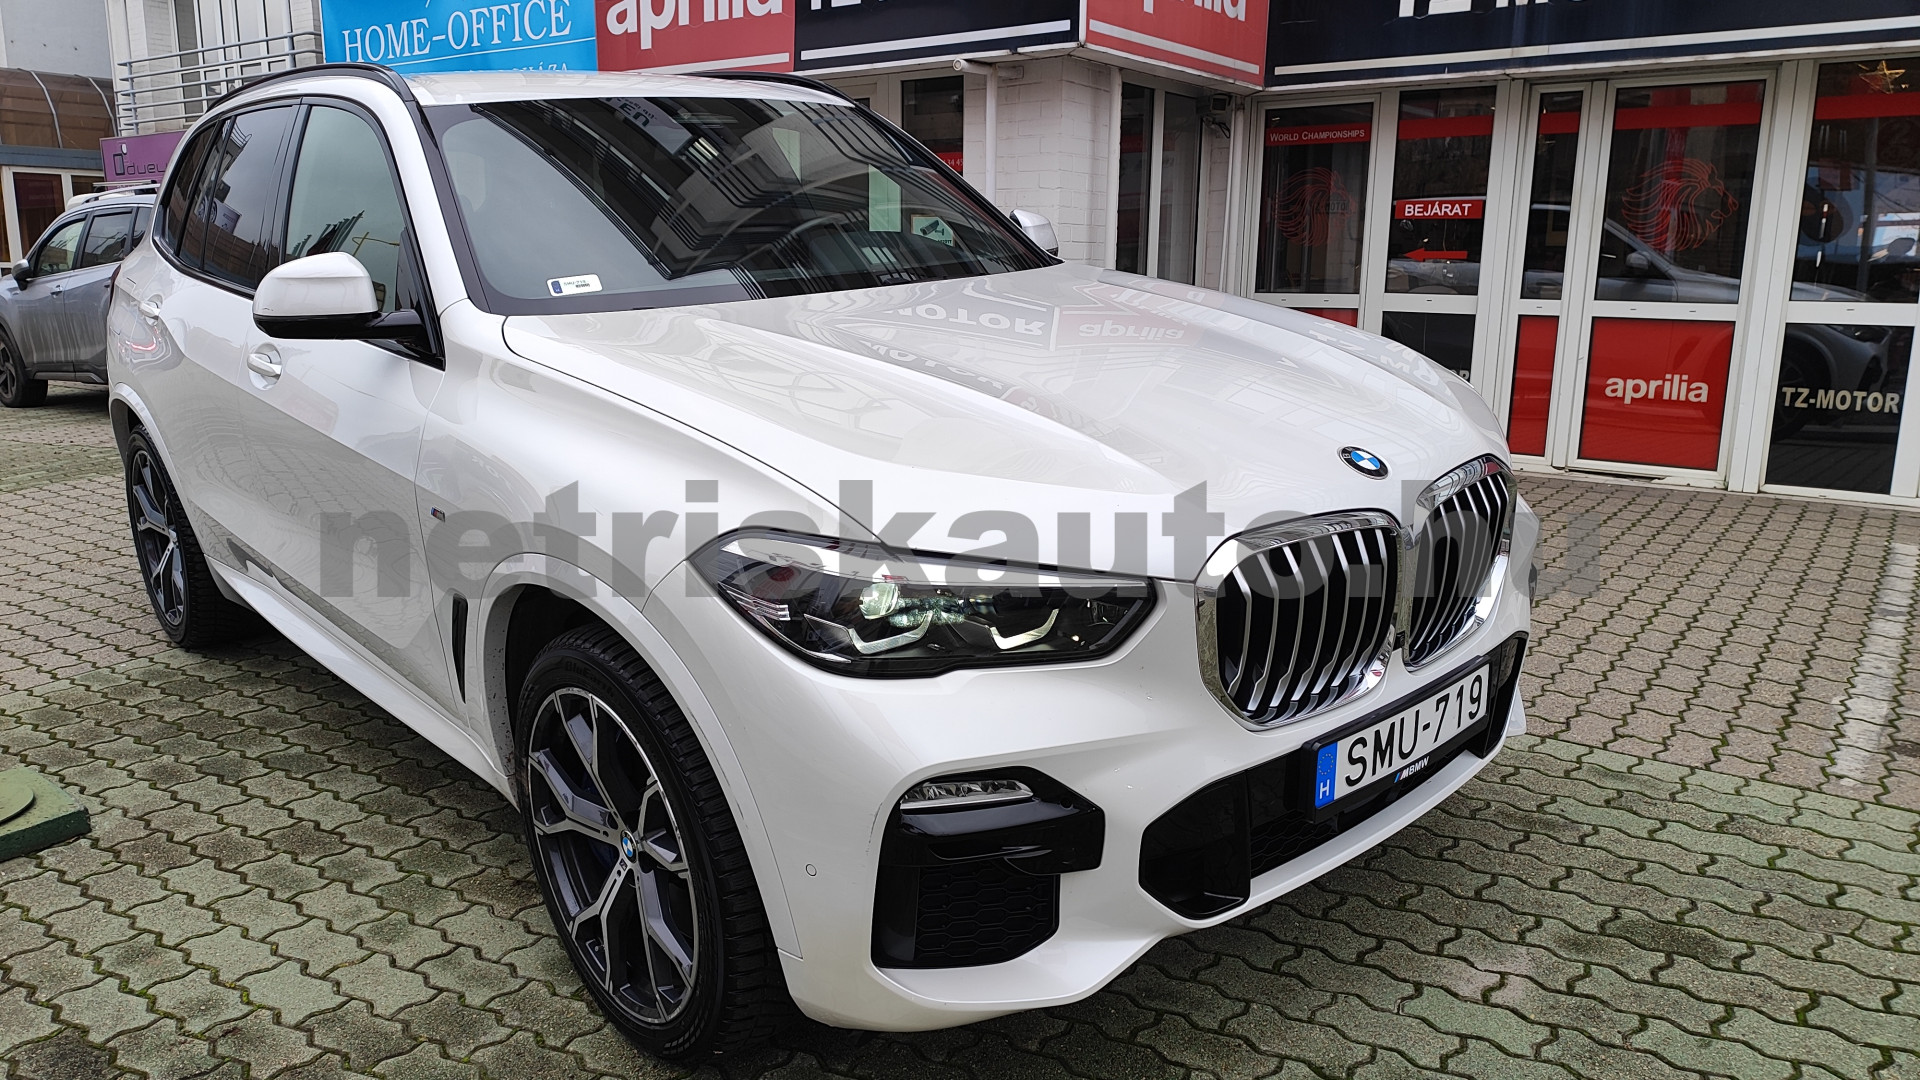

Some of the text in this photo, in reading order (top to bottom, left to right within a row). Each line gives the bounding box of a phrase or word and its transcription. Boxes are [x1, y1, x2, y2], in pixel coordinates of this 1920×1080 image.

[342, 0, 572, 63] HOME-OFFICE
[1404, 201, 1472, 217] BEJÁRAT
[1604, 373, 1709, 404] aprilia
[1781, 387, 1900, 414] TZ-MOTOR
[1345, 674, 1484, 786] SMU-719
[1319, 781, 1330, 800] H
